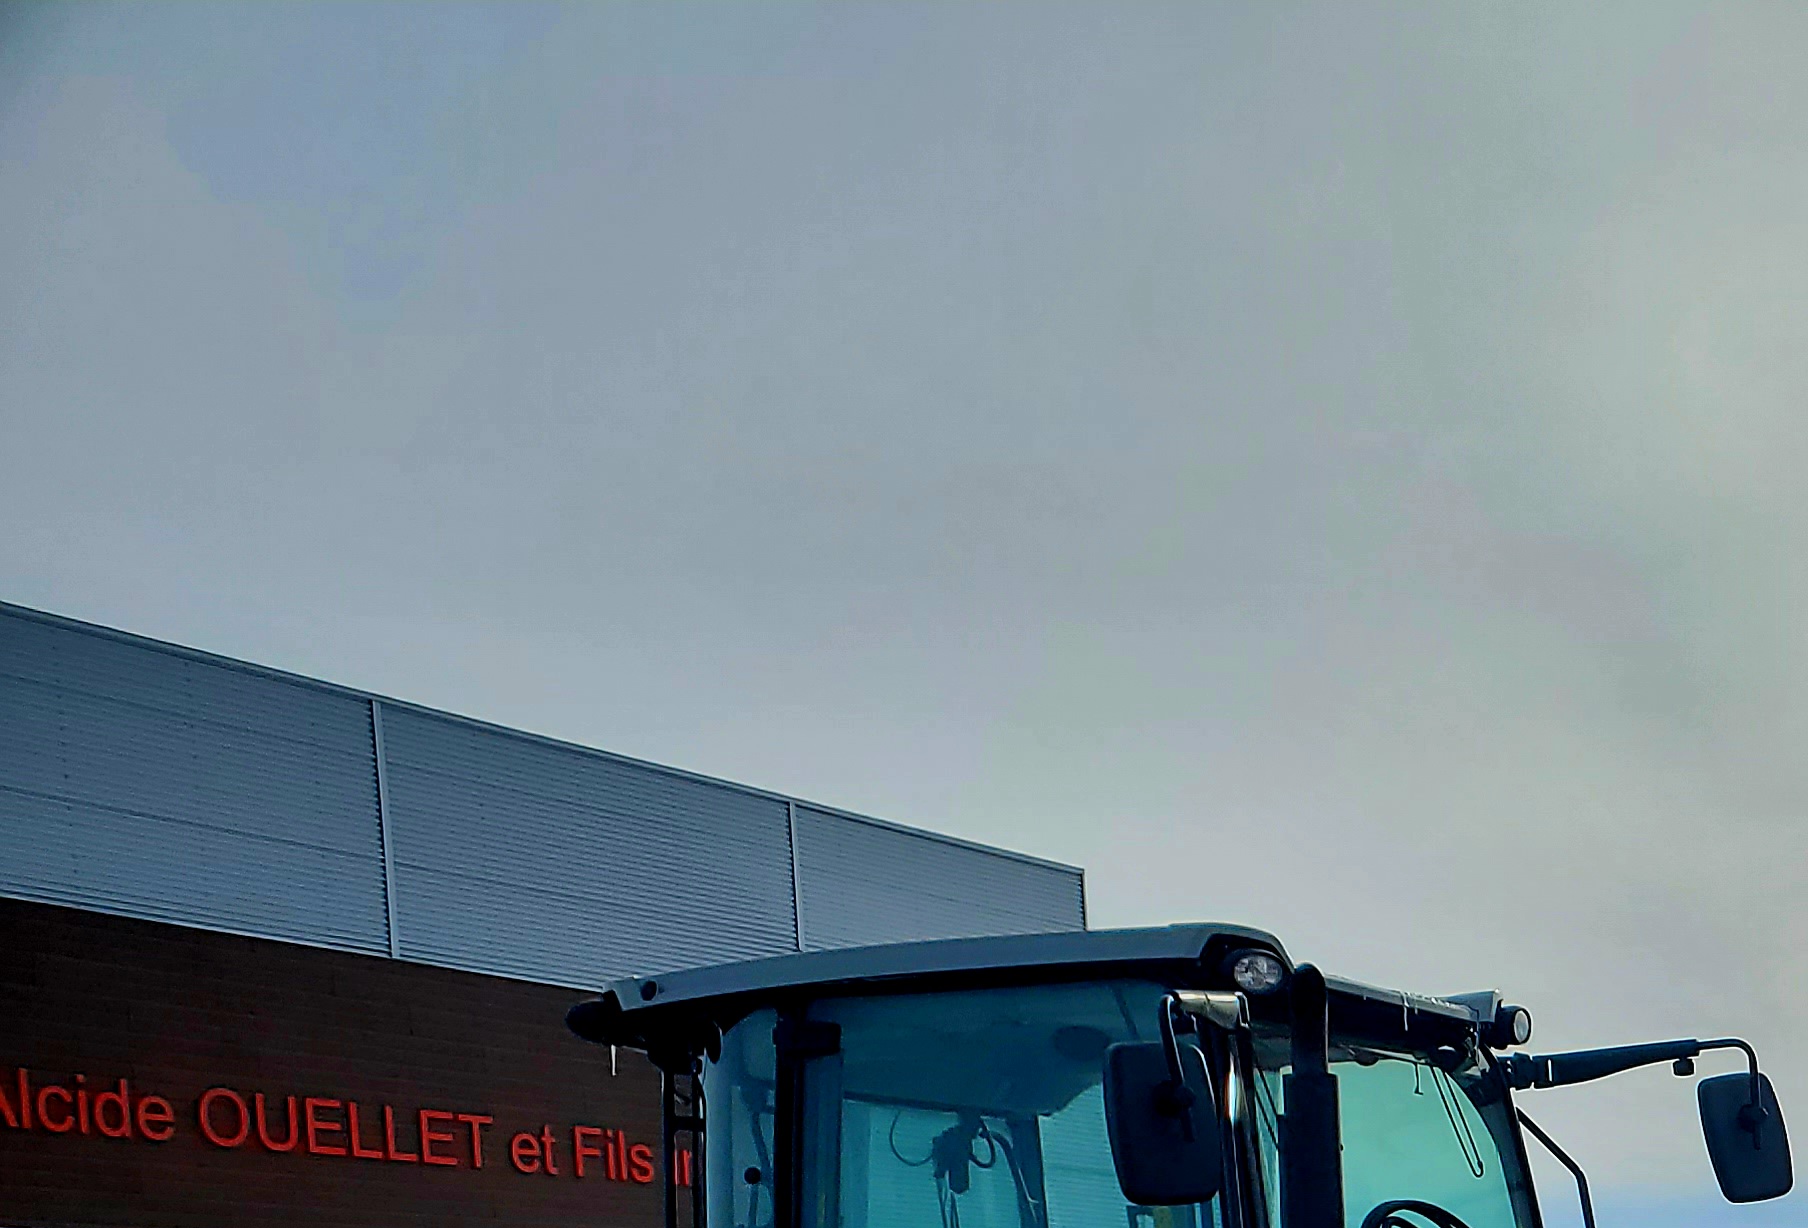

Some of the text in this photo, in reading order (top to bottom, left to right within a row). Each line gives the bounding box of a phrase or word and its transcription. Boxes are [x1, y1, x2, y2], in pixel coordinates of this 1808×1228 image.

[199, 1087, 493, 1169] OUELLET
[511, 1123, 558, 1176] et
[573, 1126, 654, 1183] Fils
